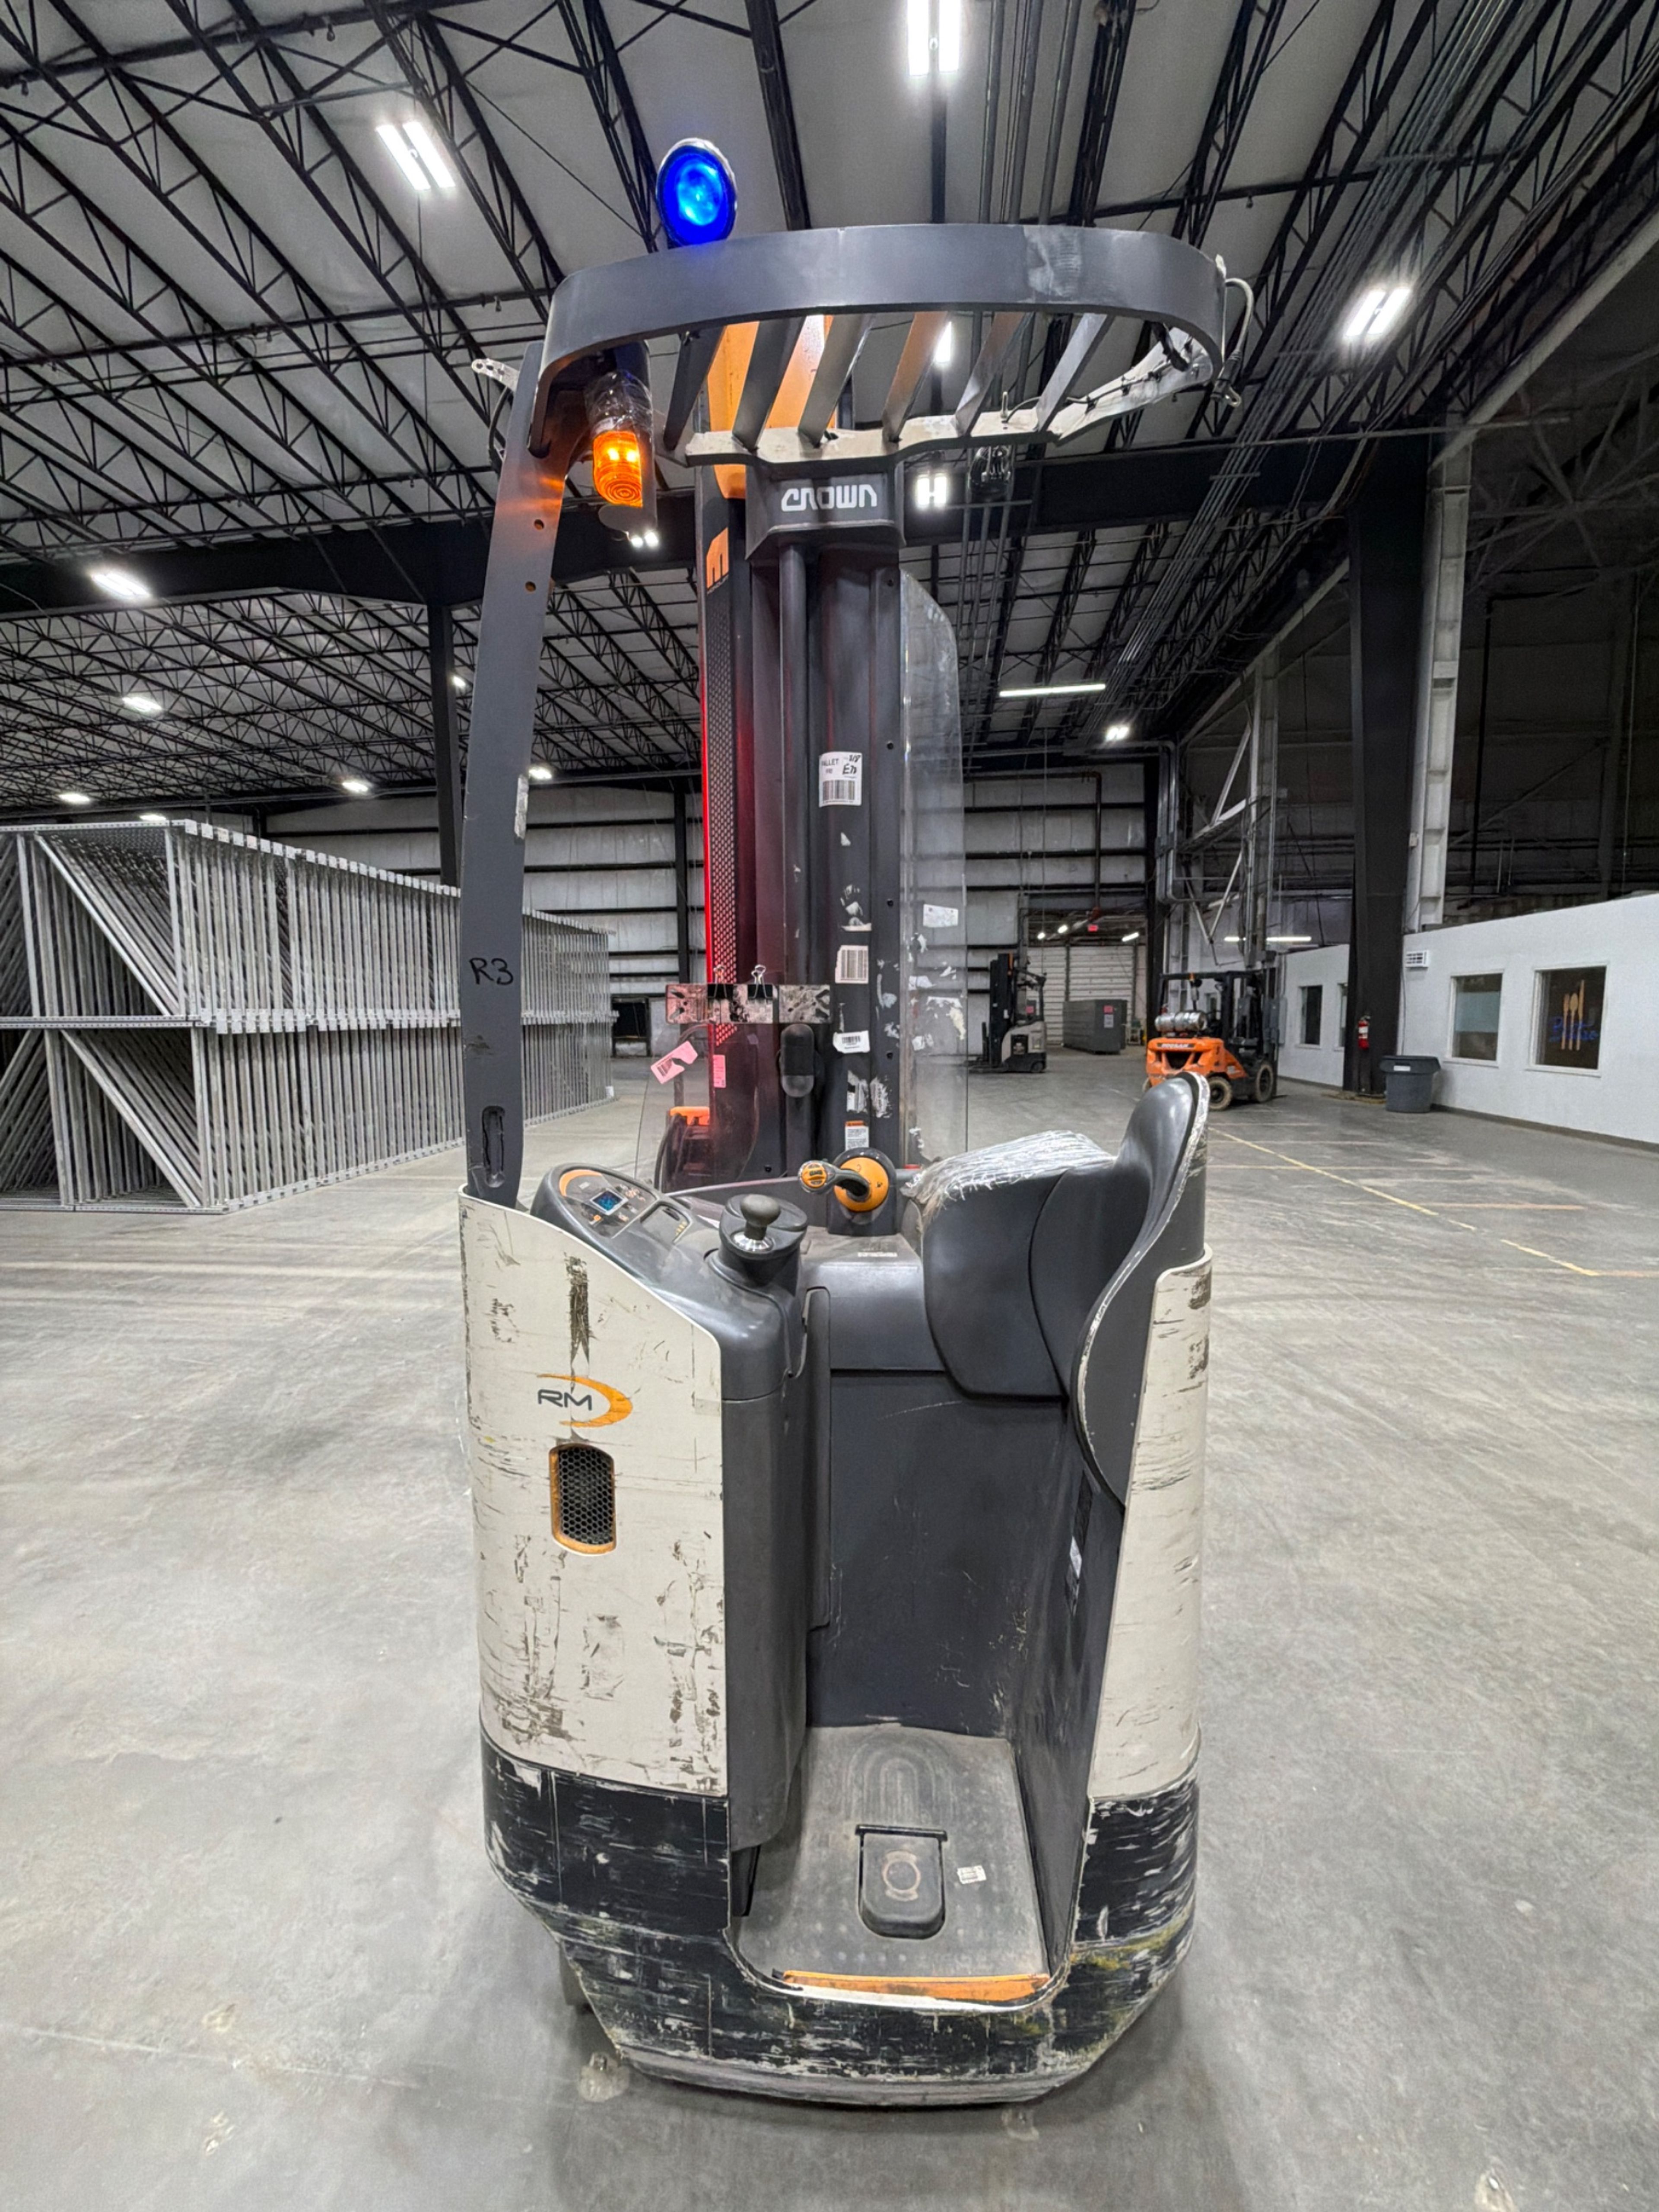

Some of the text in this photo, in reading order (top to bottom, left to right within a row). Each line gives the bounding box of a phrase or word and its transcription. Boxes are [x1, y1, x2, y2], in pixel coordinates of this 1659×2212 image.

[781, 484, 877, 512] CROWN
[469, 957, 513, 985] R3
[537, 1389, 592, 1411] RM
